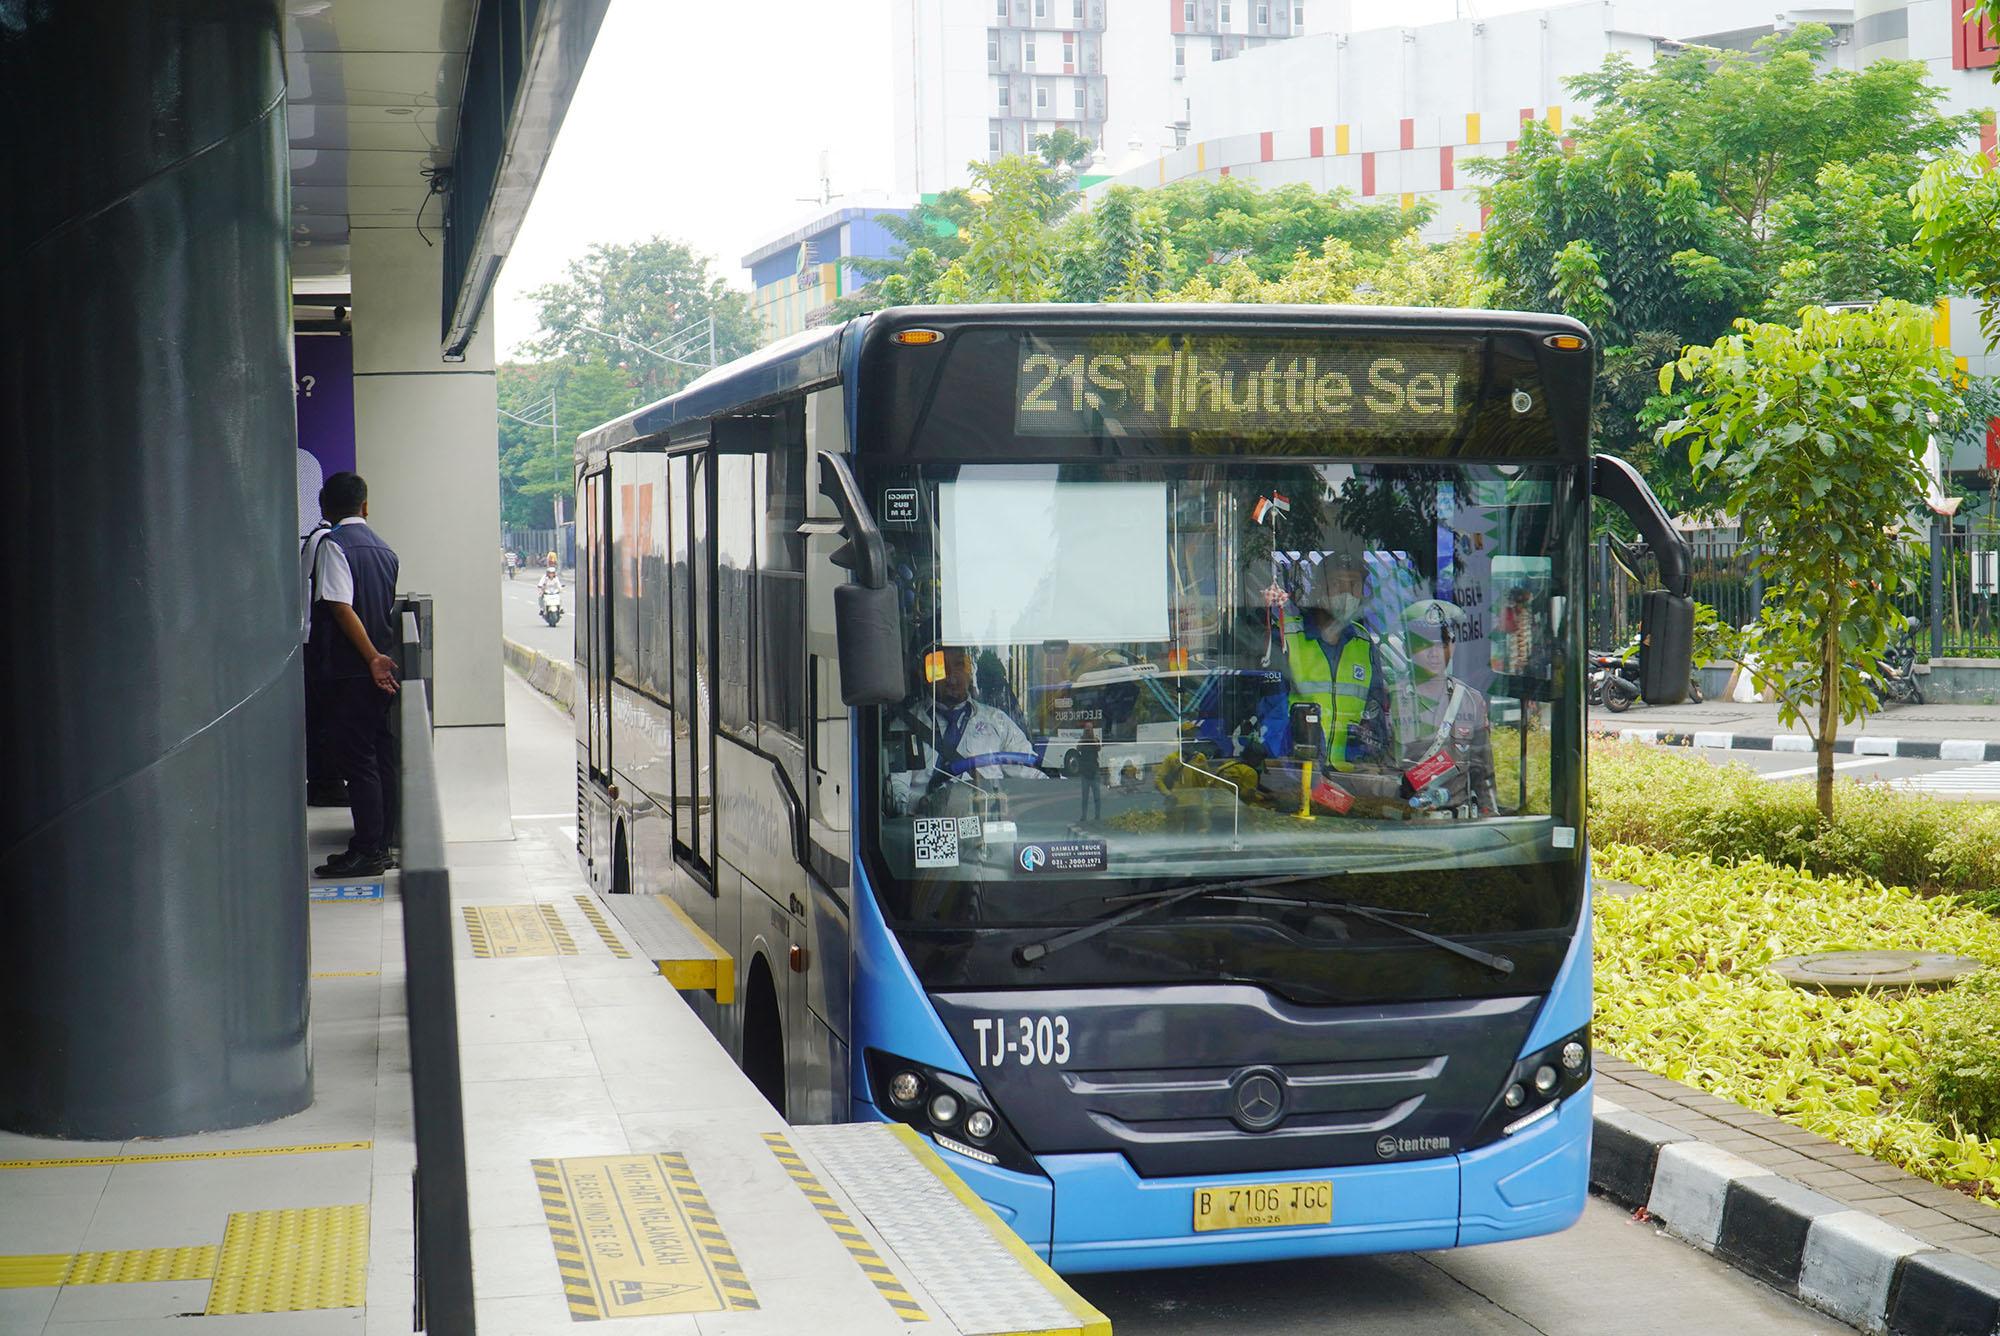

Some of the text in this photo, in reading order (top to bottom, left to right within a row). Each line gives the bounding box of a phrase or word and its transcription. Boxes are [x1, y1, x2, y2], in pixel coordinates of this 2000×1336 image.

[1182, 356, 1352, 413] huttle
[973, 1015, 1071, 1067] TJ-303
[1398, 1136, 1450, 1152] tentrem
[573, 1174, 624, 1259] PLEASE MIND THE GAP
[619, 1164, 690, 1265] HATI-HATI MELANGKAH
[1200, 1185, 1328, 1215] B 7106 TGC
